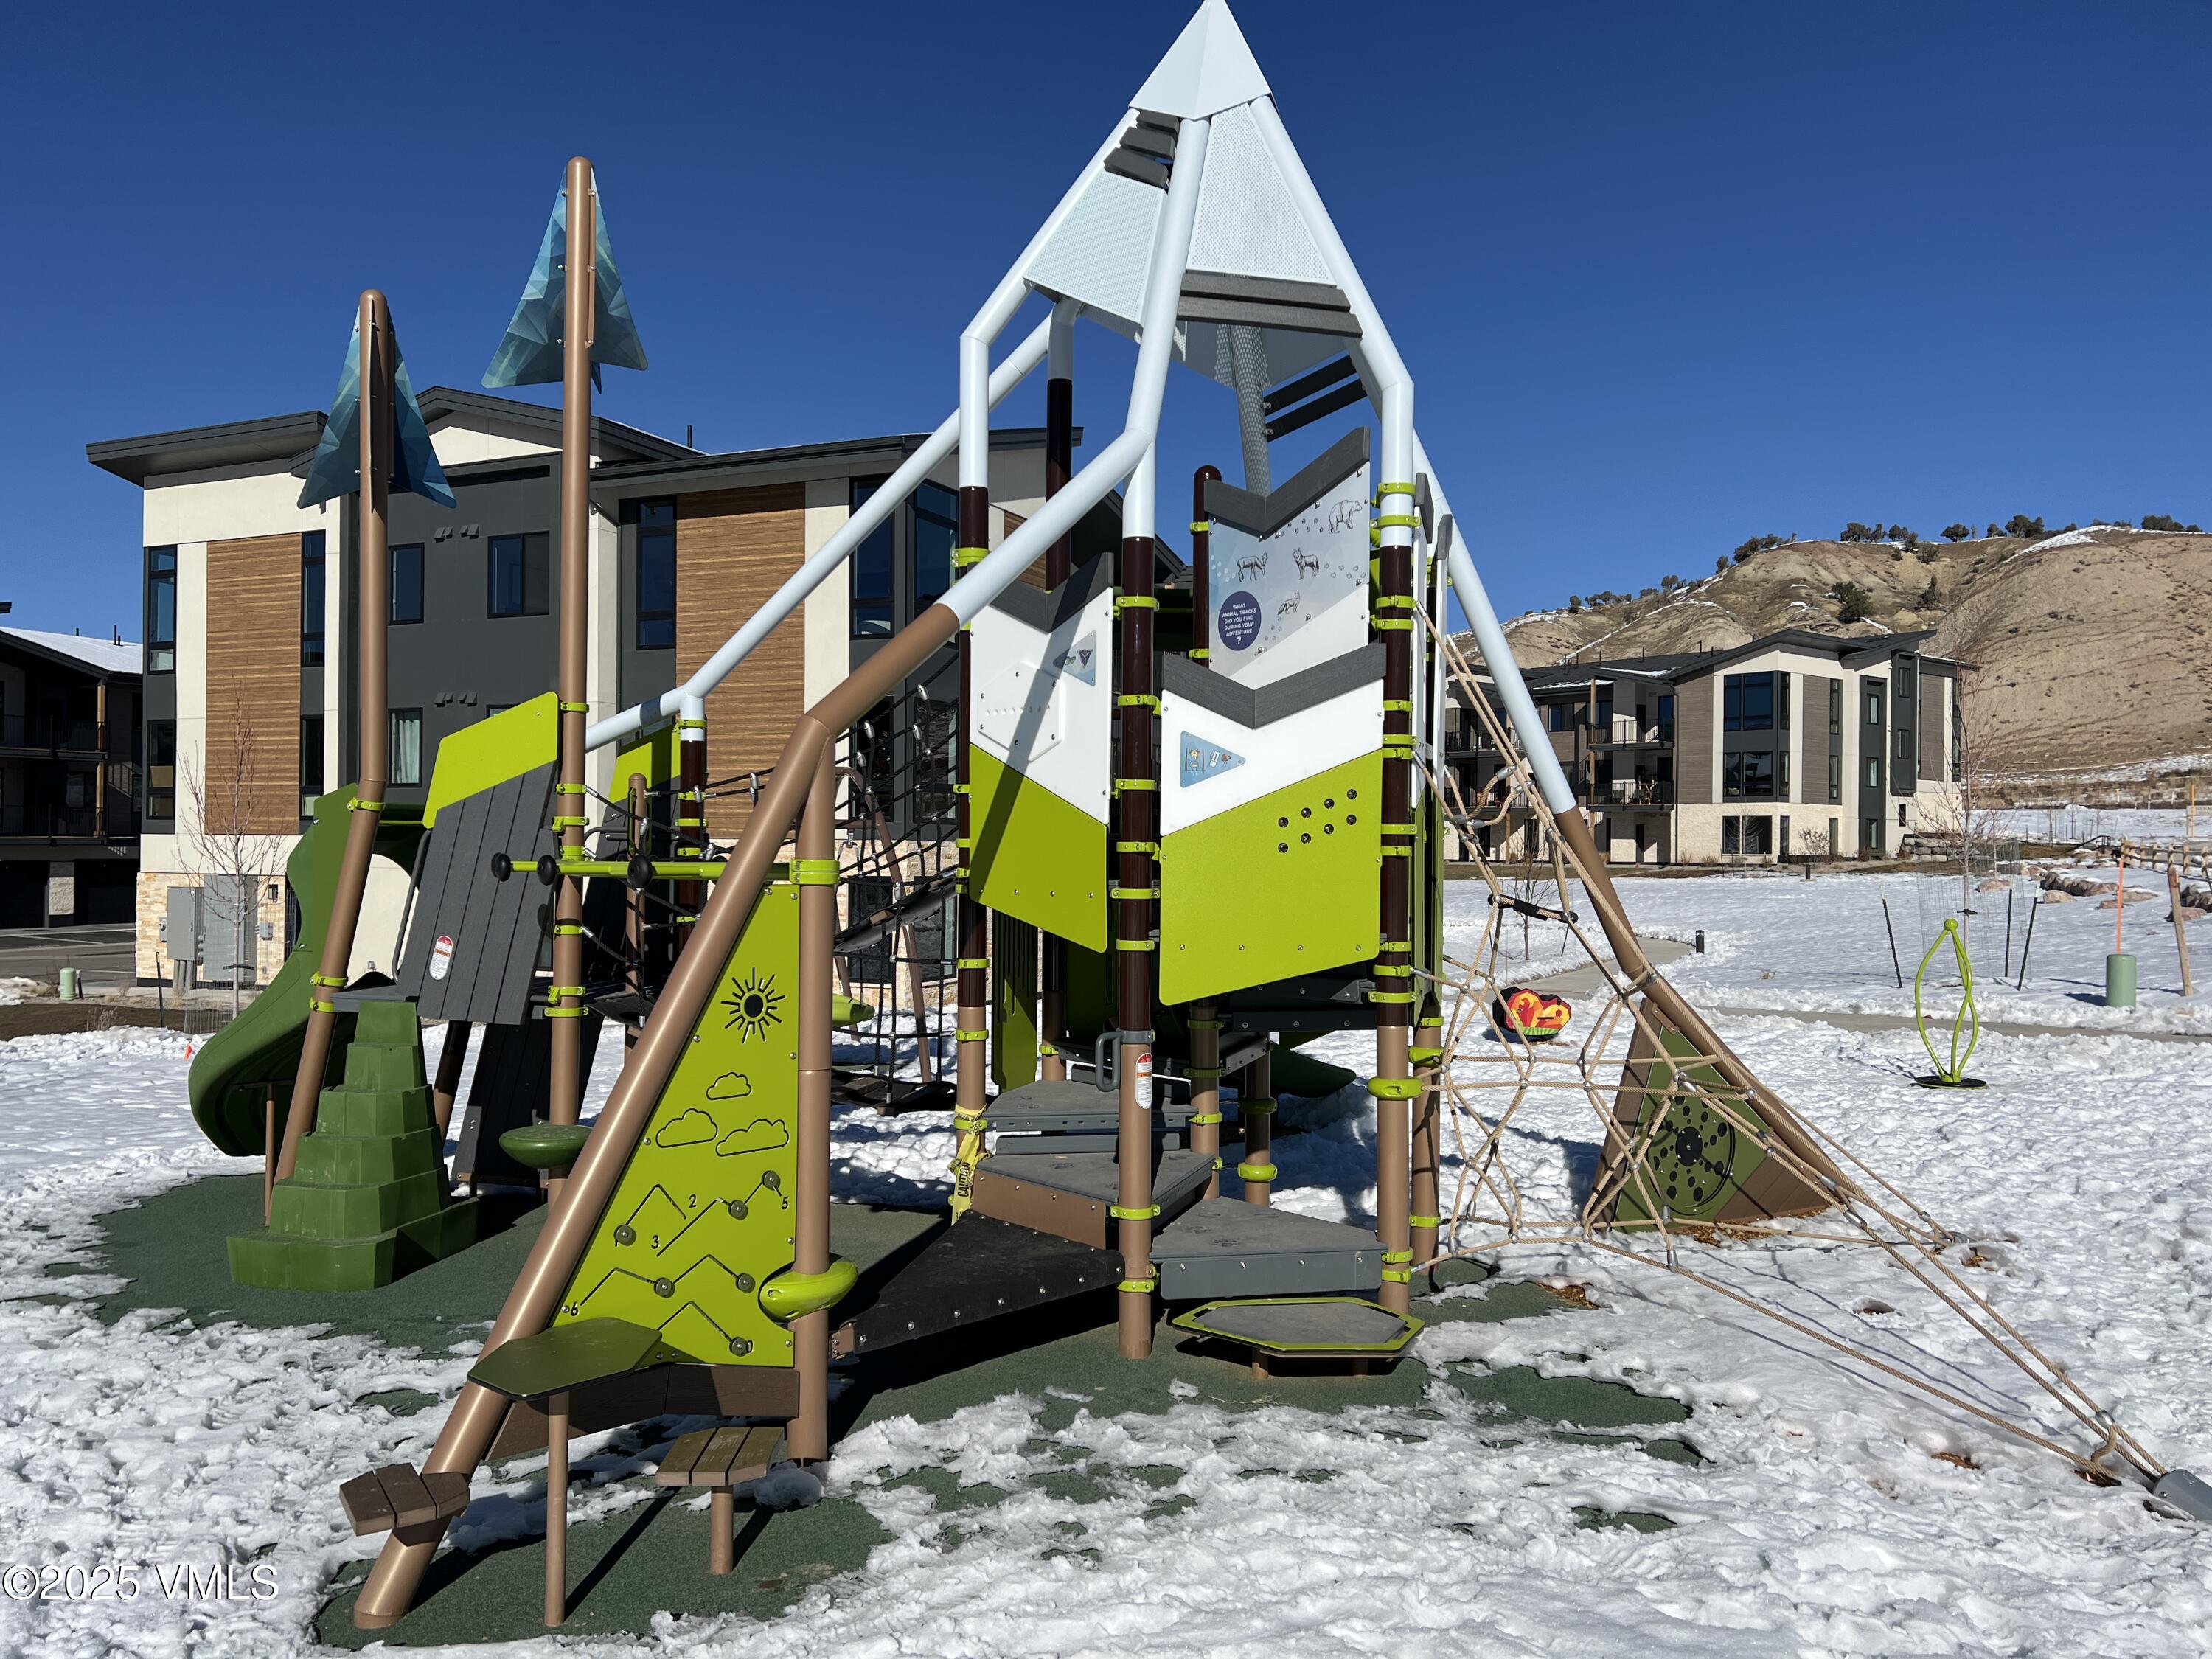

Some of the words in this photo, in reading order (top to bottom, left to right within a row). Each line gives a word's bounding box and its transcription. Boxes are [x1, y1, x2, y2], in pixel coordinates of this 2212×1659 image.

[1226, 628, 1252, 636] ADVENTURE
[1237, 636, 1242, 644] ?
[957, 1161, 971, 1197] CAUTION
[689, 1194, 697, 1208] 2
[782, 1195, 789, 1210] 5
[651, 1234, 660, 1249] 3
[570, 1301, 579, 1317] 6
